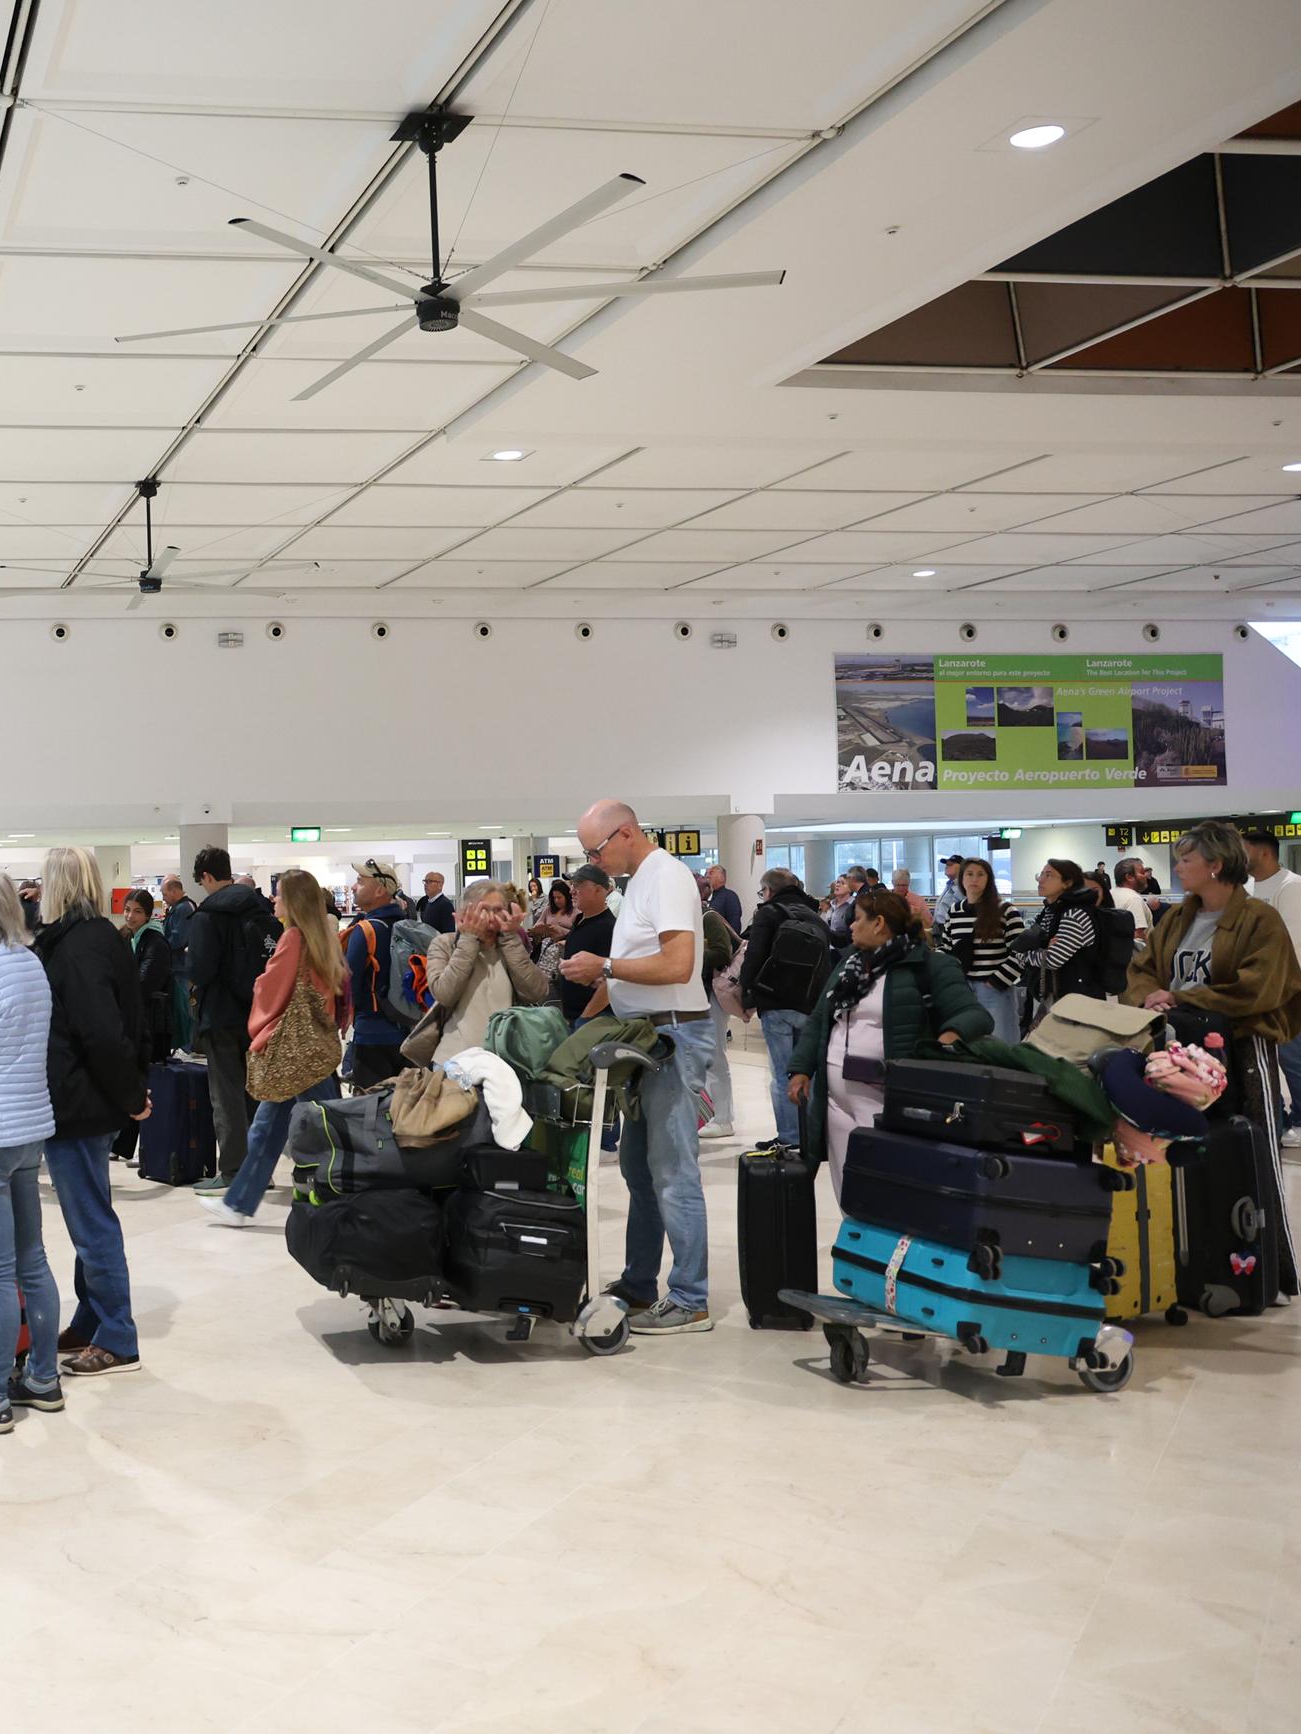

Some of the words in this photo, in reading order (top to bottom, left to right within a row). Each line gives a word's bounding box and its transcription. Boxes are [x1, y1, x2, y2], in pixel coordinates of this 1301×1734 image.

[939, 659, 986, 668] Lanzarote
[1086, 659, 1132, 667] Lanzarote
[1057, 688, 1085, 696] Aena's
[1118, 687, 1149, 696] Airport
[1152, 687, 1183, 696] Project
[842, 755, 935, 783] Aena
[943, 769, 1009, 784] Proyecto
[1014, 768, 1100, 784] Aeropuerto
[1105, 768, 1147, 780] Verde
